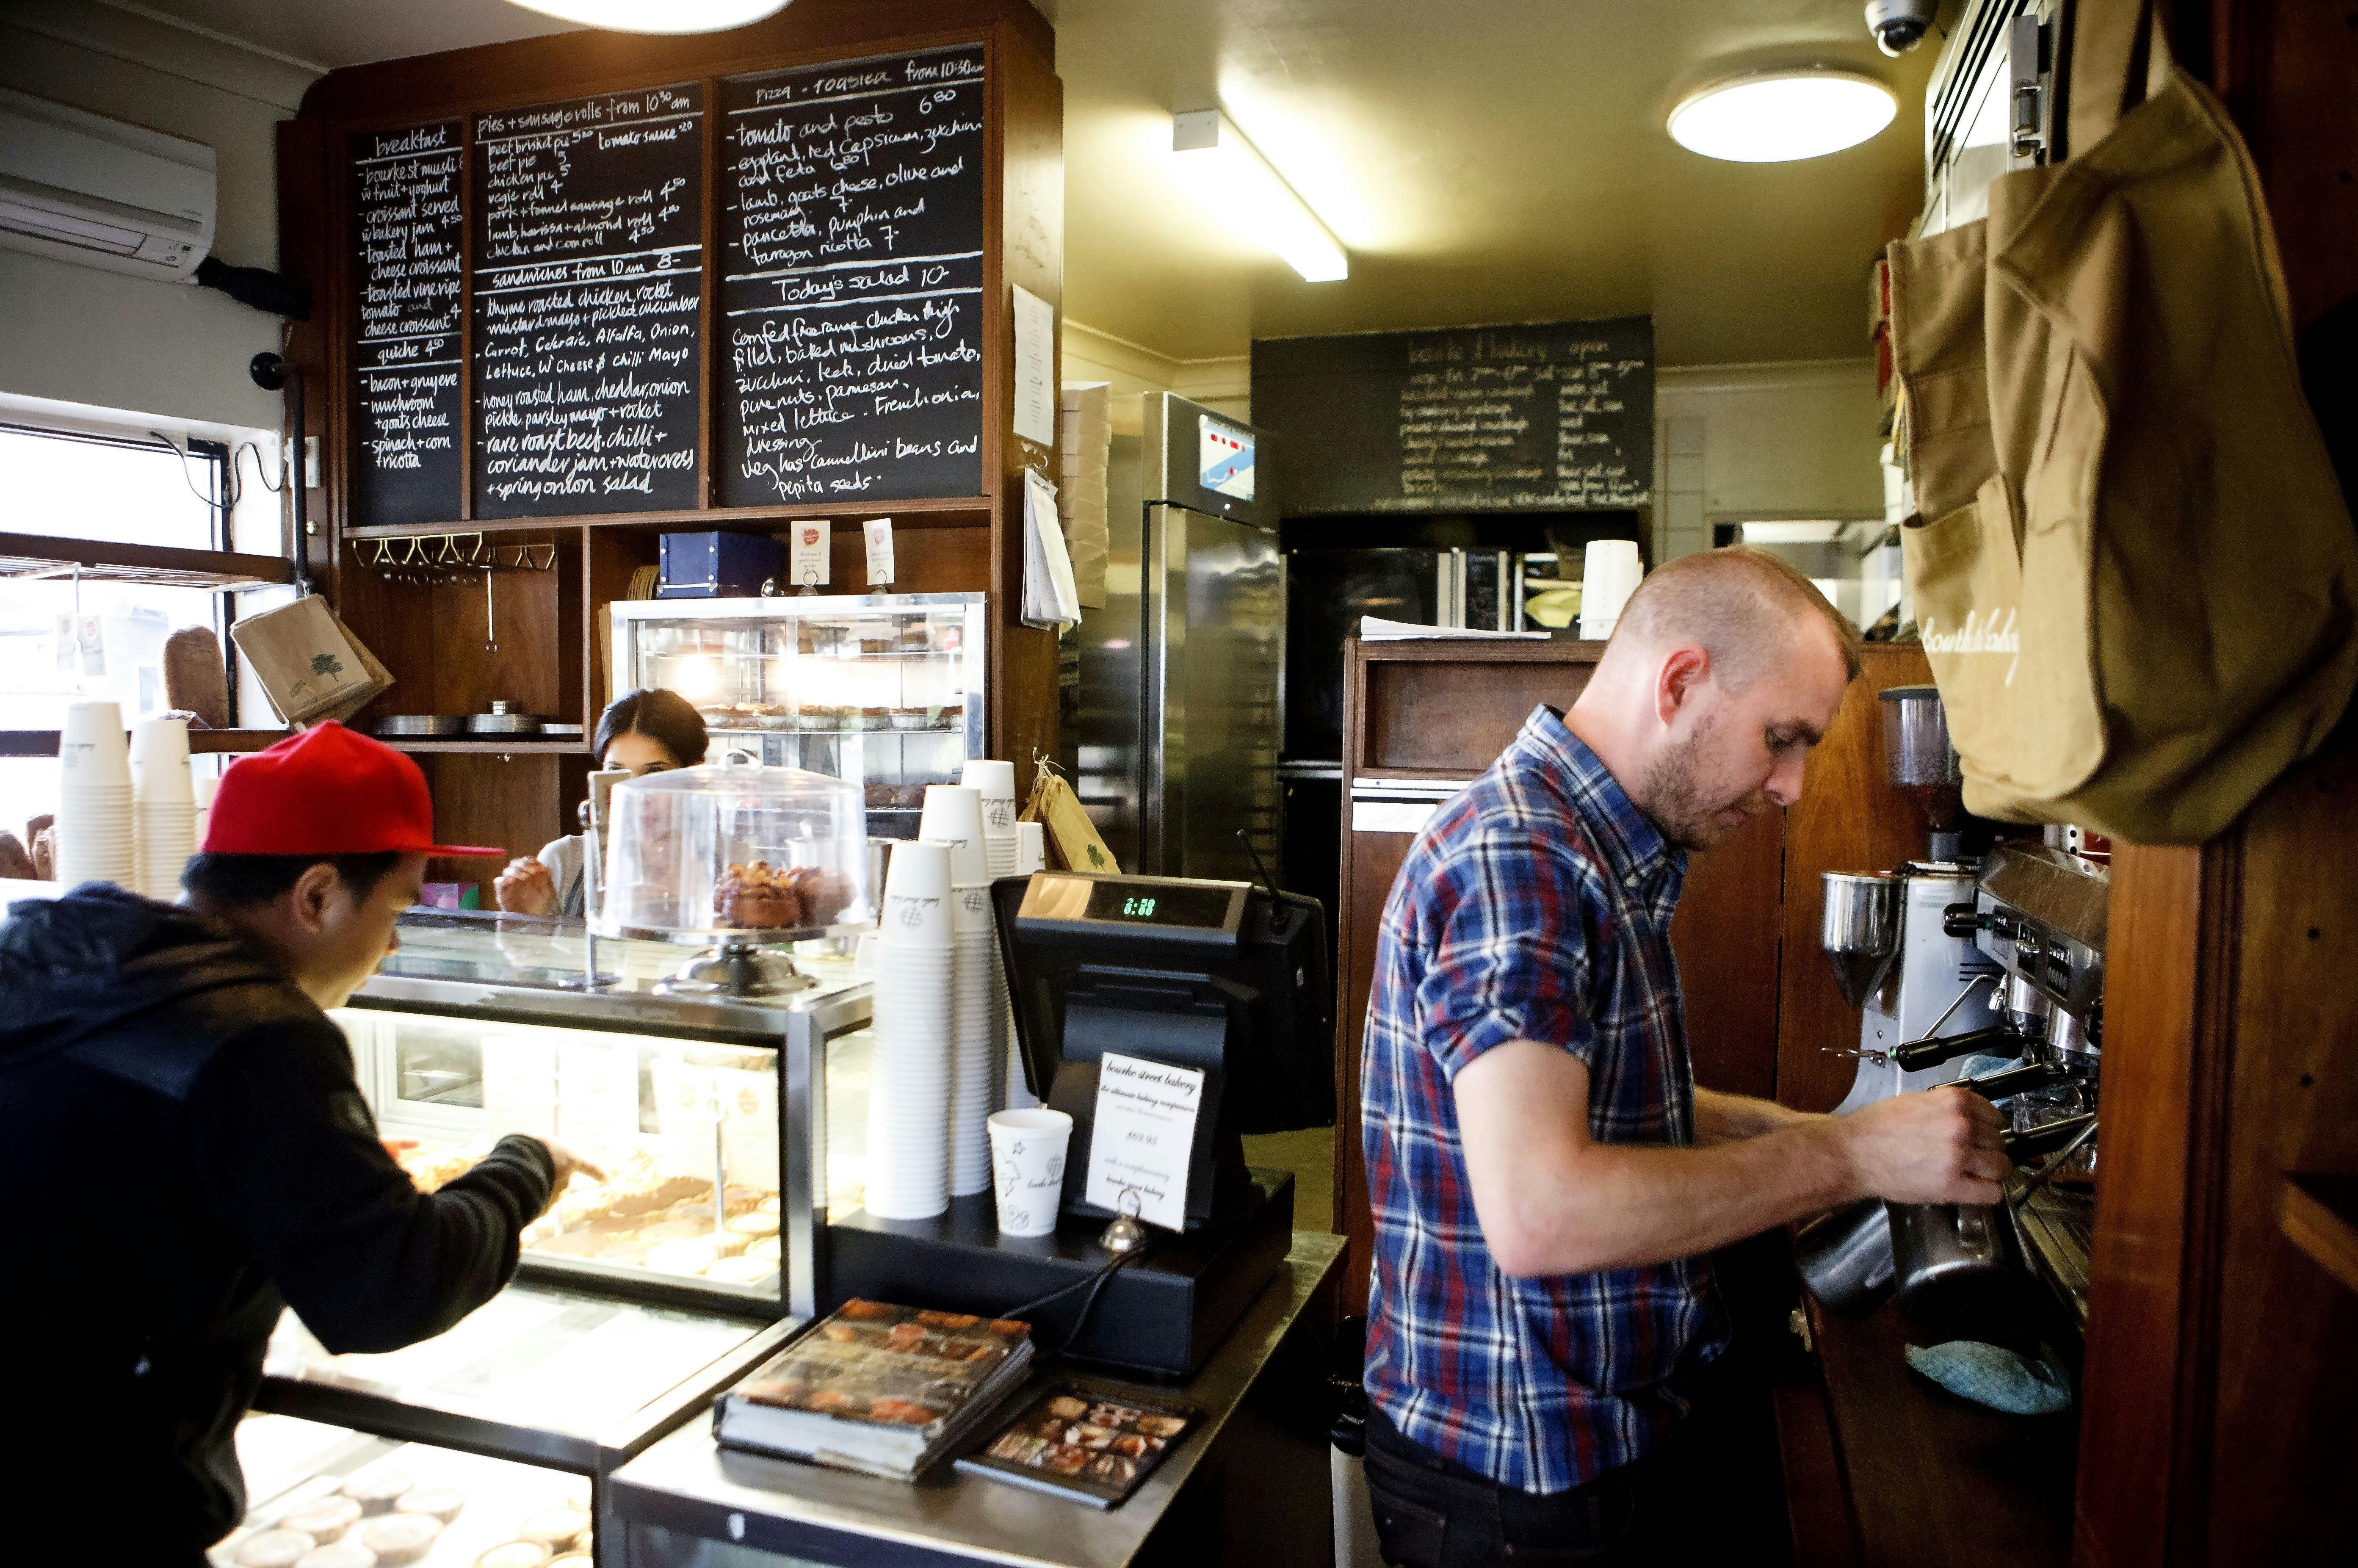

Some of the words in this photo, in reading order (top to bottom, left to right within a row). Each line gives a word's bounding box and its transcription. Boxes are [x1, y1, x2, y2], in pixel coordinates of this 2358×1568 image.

[904, 60, 938, 82] from
[478, 115, 504, 140] pies
[519, 109, 572, 128] sausage
[575, 101, 601, 121] rolls
[606, 98, 639, 121] from
[739, 118, 792, 147] tomato
[799, 113, 838, 138] and
[843, 104, 893, 140] pesto
[376, 125, 446, 157] breakfast
[489, 139, 513, 156] beef
[515, 134, 552, 154] brisket
[554, 136, 569, 157] pie
[599, 131, 642, 150] tomato
[643, 128, 677, 144] sauce
[809, 140, 836, 158] red
[366, 161, 405, 185] bourke
[489, 152, 517, 174] beef
[519, 153, 536, 175] pie
[739, 173, 771, 188] and
[776, 161, 816, 183] feta
[488, 172, 534, 189] chicken
[538, 171, 554, 190] pie
[788, 184, 827, 208] goats
[886, 163, 928, 186] olive
[931, 156, 963, 178] and
[367, 197, 417, 224] croissant
[422, 194, 460, 217] served
[488, 204, 518, 227] pork
[570, 197, 625, 218] sausage
[628, 189, 652, 205] roll
[489, 189, 520, 210] vegie
[523, 184, 544, 201] roll
[521, 221, 562, 238] harissa
[573, 215, 622, 232] almond
[628, 212, 652, 228] roll
[829, 204, 890, 236] pumpkin
[894, 197, 925, 219] and
[412, 222, 434, 243] jam
[487, 240, 530, 259] chicken
[534, 236, 553, 252] and
[582, 232, 603, 248] roll
[368, 241, 406, 264] toasted
[415, 238, 443, 257] ham
[751, 246, 813, 267] tarragon
[821, 231, 872, 254] ricotta
[371, 263, 406, 281] cheese
[409, 252, 461, 276] croissant
[492, 266, 567, 288] sandwiches
[572, 263, 605, 280] from
[368, 279, 411, 302] toasted
[413, 280, 437, 298] vine
[438, 279, 460, 301] ripe
[772, 275, 843, 302] Today's
[849, 265, 909, 290] salad
[361, 301, 401, 320] tomato
[408, 297, 432, 312] and
[487, 297, 525, 322] thyme
[529, 288, 574, 314] roasted
[636, 280, 673, 299] rocket
[365, 320, 397, 337] cheese
[400, 315, 451, 333] croissant
[487, 315, 545, 335] mustard
[546, 313, 580, 332] mayo
[592, 302, 637, 327] pickled
[639, 296, 699, 316] cucumber
[378, 341, 418, 365] quiche
[649, 347, 688, 366] Mayo
[786, 339, 836, 364] baked
[370, 374, 401, 393] bacon
[411, 373, 457, 396] gruyere
[483, 391, 513, 414] honey
[515, 384, 554, 407] roasted
[649, 377, 690, 397] onion
[372, 393, 434, 413] mushroom
[525, 406, 567, 430] parsley
[570, 406, 608, 428] mayo
[620, 398, 662, 419] rocket
[412, 410, 449, 429] cheese
[743, 412, 787, 437] mixed
[371, 432, 416, 454] spinach
[426, 436, 451, 449] corn
[487, 436, 518, 454] rare
[522, 429, 565, 453] roast
[607, 424, 652, 448] chilli
[747, 437, 822, 462] dressing
[488, 447, 570, 475] coriander
[567, 453, 608, 481] jam
[780, 452, 803, 473] has
[896, 437, 941, 459] beans
[948, 436, 977, 454] and
[544, 477, 596, 495] onion
[603, 470, 653, 494] salad
[778, 474, 824, 501] pepita
[1106, 1060, 1137, 1076] bourke
[1138, 1070, 1163, 1083] street
[1164, 1073, 1196, 1097] bakery
